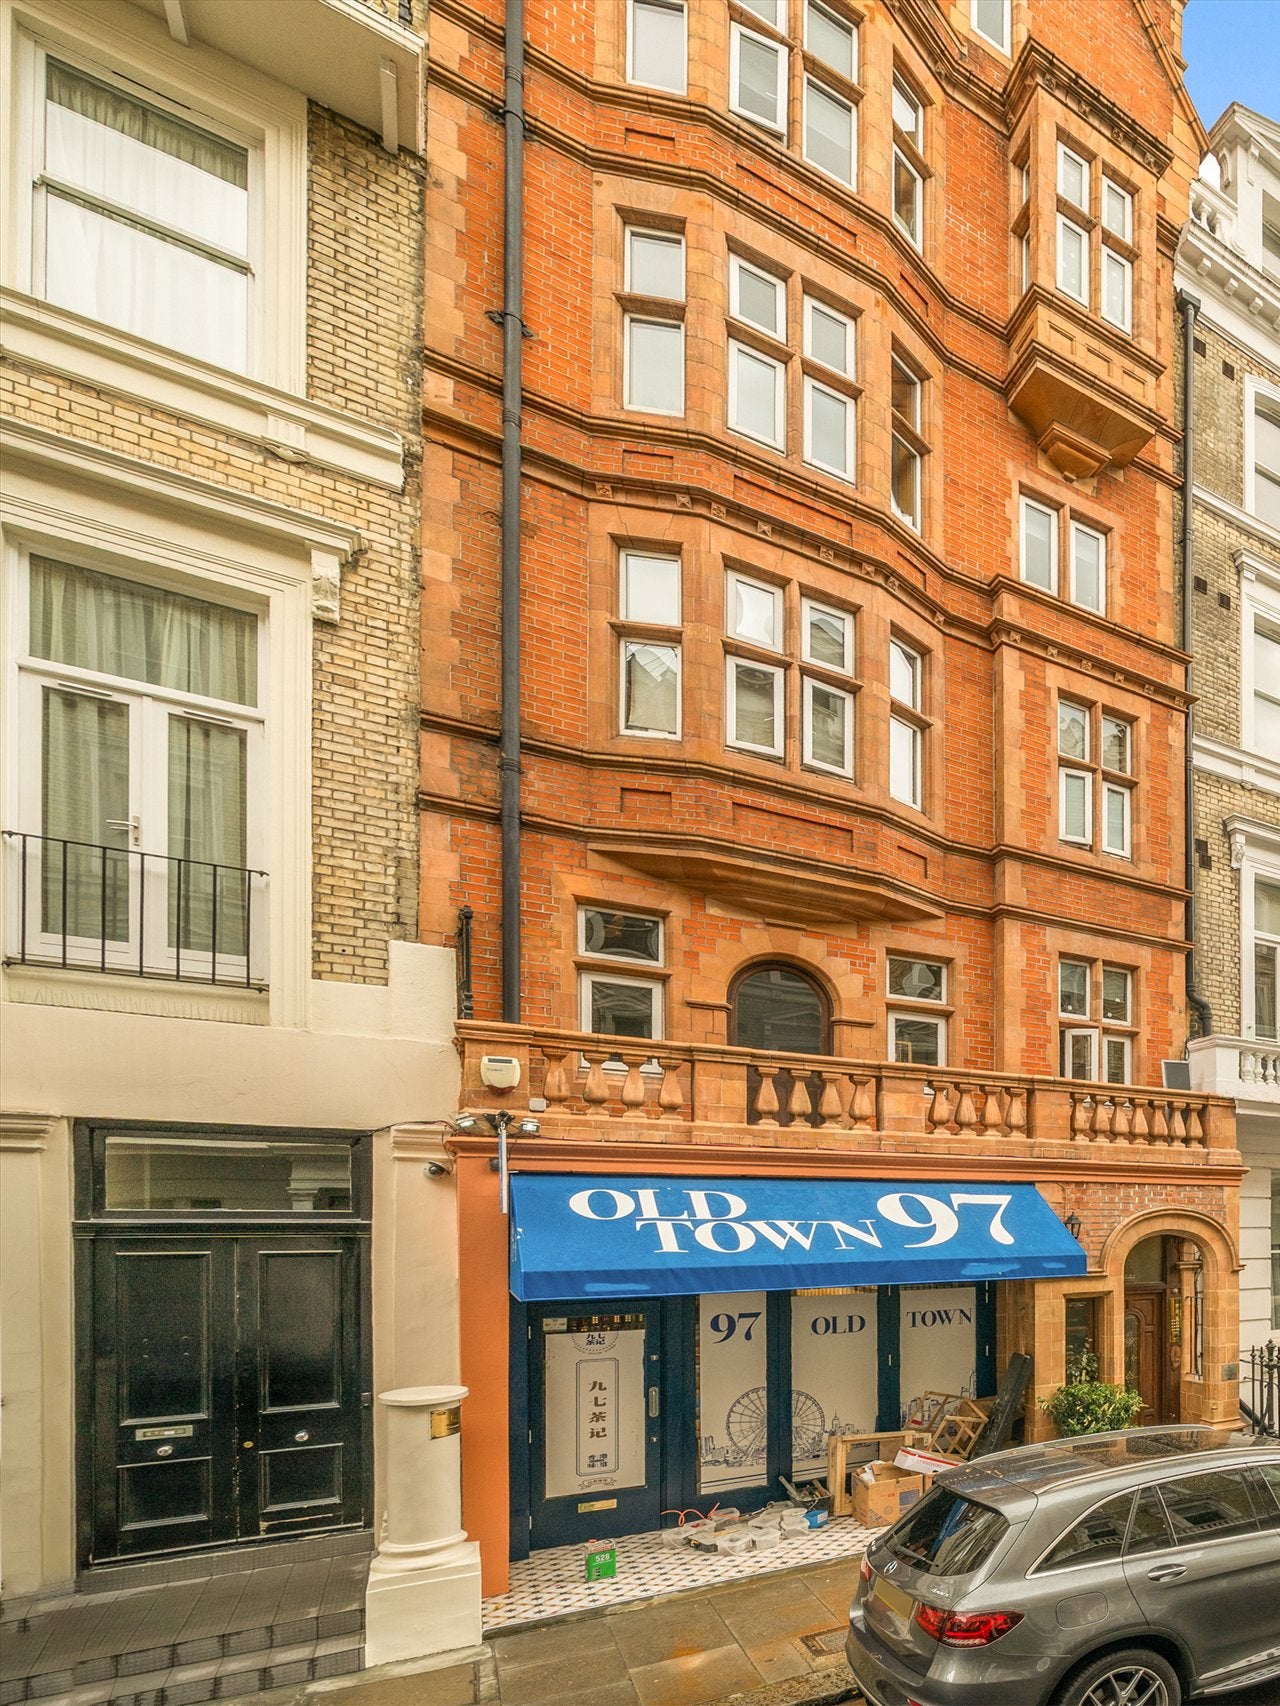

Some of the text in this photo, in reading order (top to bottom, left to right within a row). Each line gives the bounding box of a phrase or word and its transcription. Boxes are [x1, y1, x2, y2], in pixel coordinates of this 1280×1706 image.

[569, 1188, 747, 1220] OLD
[876, 1192, 1015, 1248] 97
[635, 1219, 883, 1253] TOWN
[710, 1308, 973, 1344] 97 OLD TOWN
[595, 1553, 610, 1563] 528
